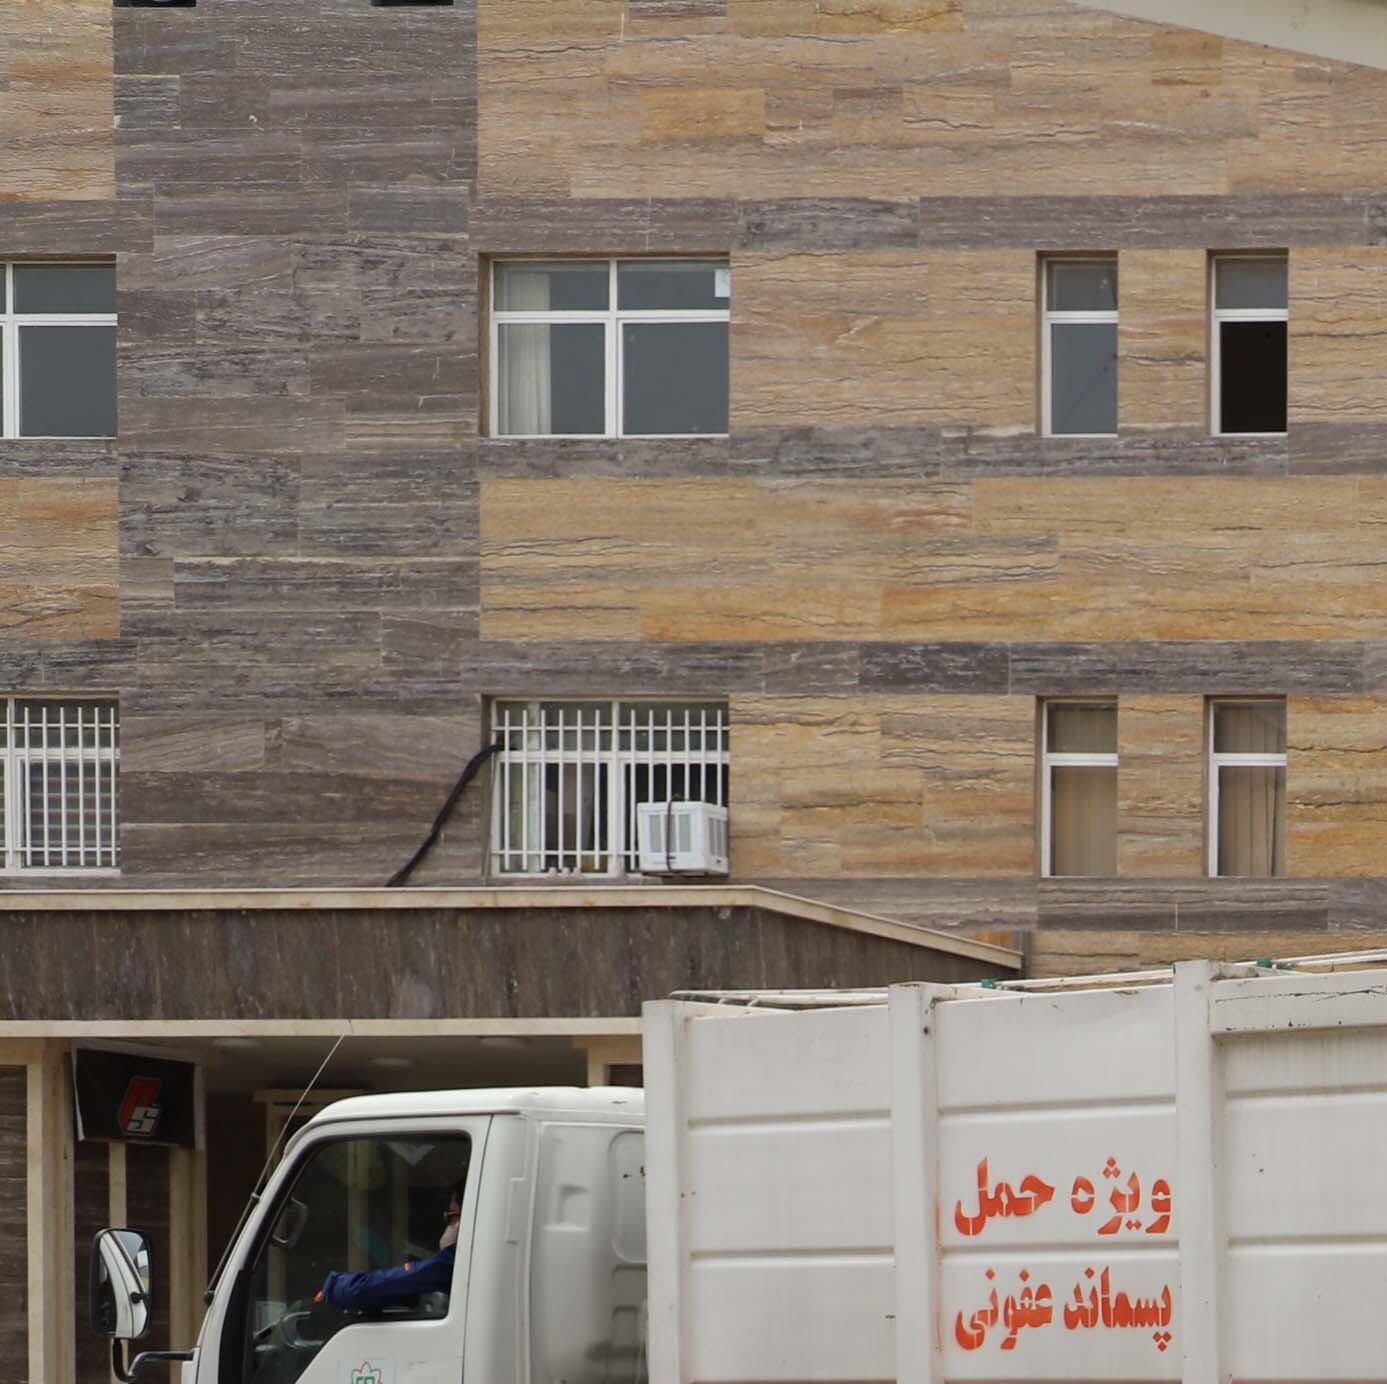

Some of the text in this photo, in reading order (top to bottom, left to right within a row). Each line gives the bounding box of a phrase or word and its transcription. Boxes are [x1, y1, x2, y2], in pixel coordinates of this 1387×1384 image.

[954, 1156, 1172, 1237] ویژه حمل
[954, 1266, 1173, 1352] پسماند عفونی
